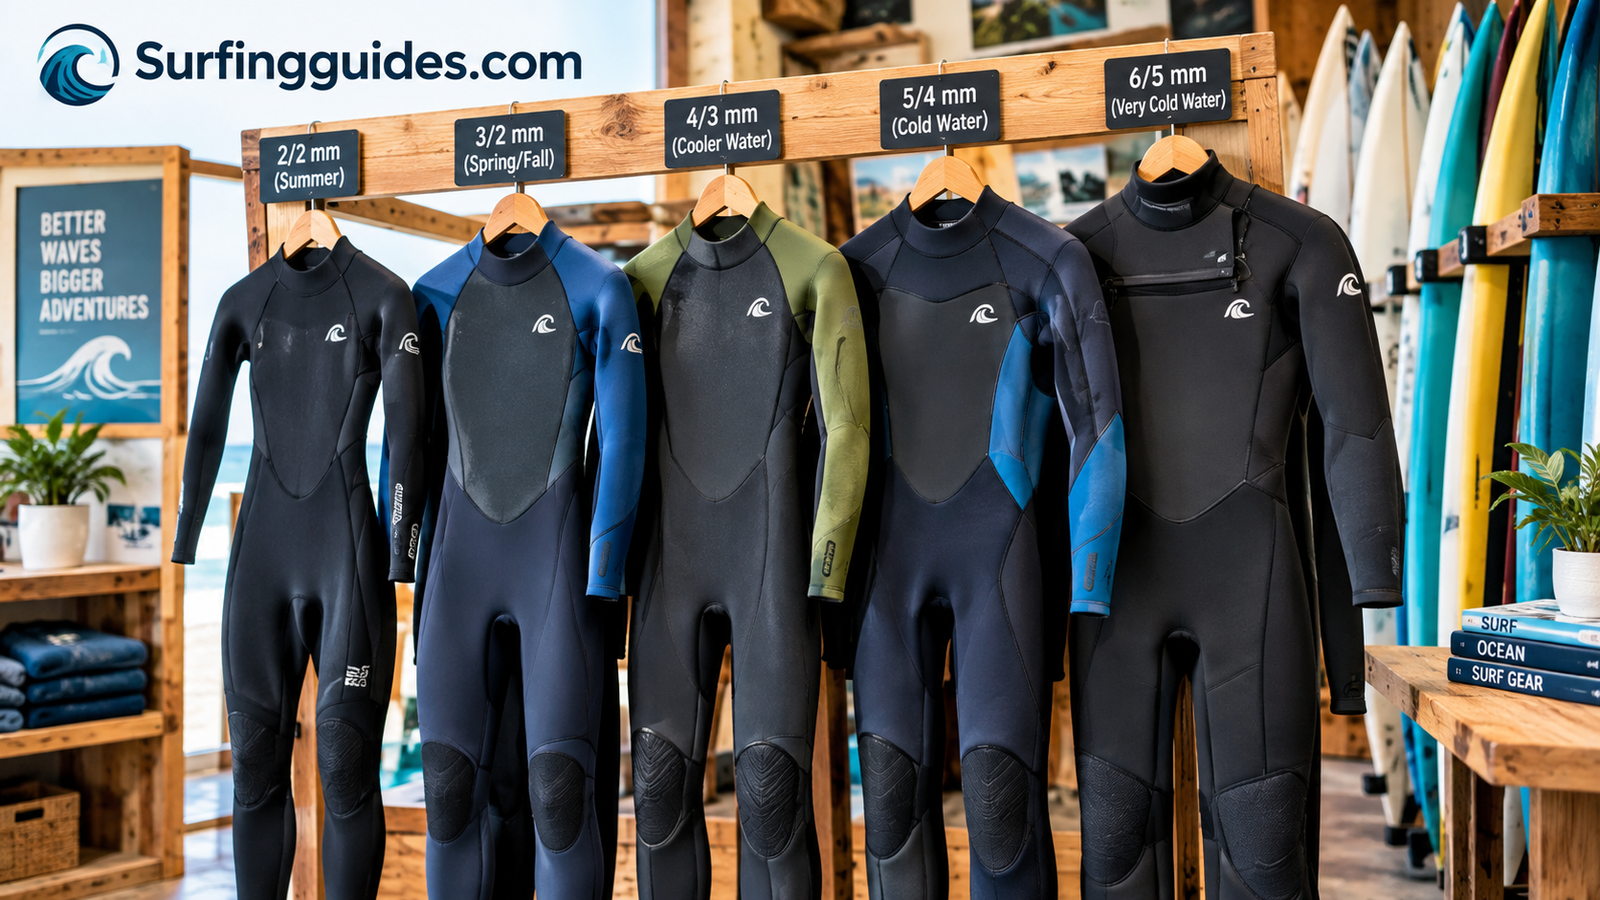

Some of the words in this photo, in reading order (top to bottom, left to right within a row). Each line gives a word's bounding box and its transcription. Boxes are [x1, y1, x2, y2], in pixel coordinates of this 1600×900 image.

[1129, 65, 1163, 89] 6/5
[1170, 67, 1207, 85] mm
[902, 85, 936, 110] 5/4
[941, 87, 977, 106] mm
[1111, 97, 1147, 119] (Very
[1149, 93, 1179, 113] Cold
[1182, 89, 1226, 110] Water)
[686, 105, 719, 130] 4/3
[725, 107, 758, 125] mm
[892, 114, 932, 139] (Cold
[936, 110, 988, 133] Water)
[475, 125, 506, 149] 3/2
[511, 126, 544, 144] mm
[672, 134, 722, 159] (Cooler
[725, 129, 772, 152] Water)
[277, 144, 306, 167] 2/2
[310, 145, 341, 163] mm
[464, 148, 555, 176] (Spring/Fall)
[274, 166, 345, 193] (Summer)
[41, 210, 106, 236] BETTER
[40, 239, 102, 265] WAVES
[40, 268, 103, 294] BIGGER
[39, 294, 149, 322] ADVENTURES
[1481, 616, 1518, 634] SURF
[1477, 639, 1526, 662] OCEAN
[1472, 665, 1505, 685] SURF
[1507, 670, 1544, 692] GEAR
